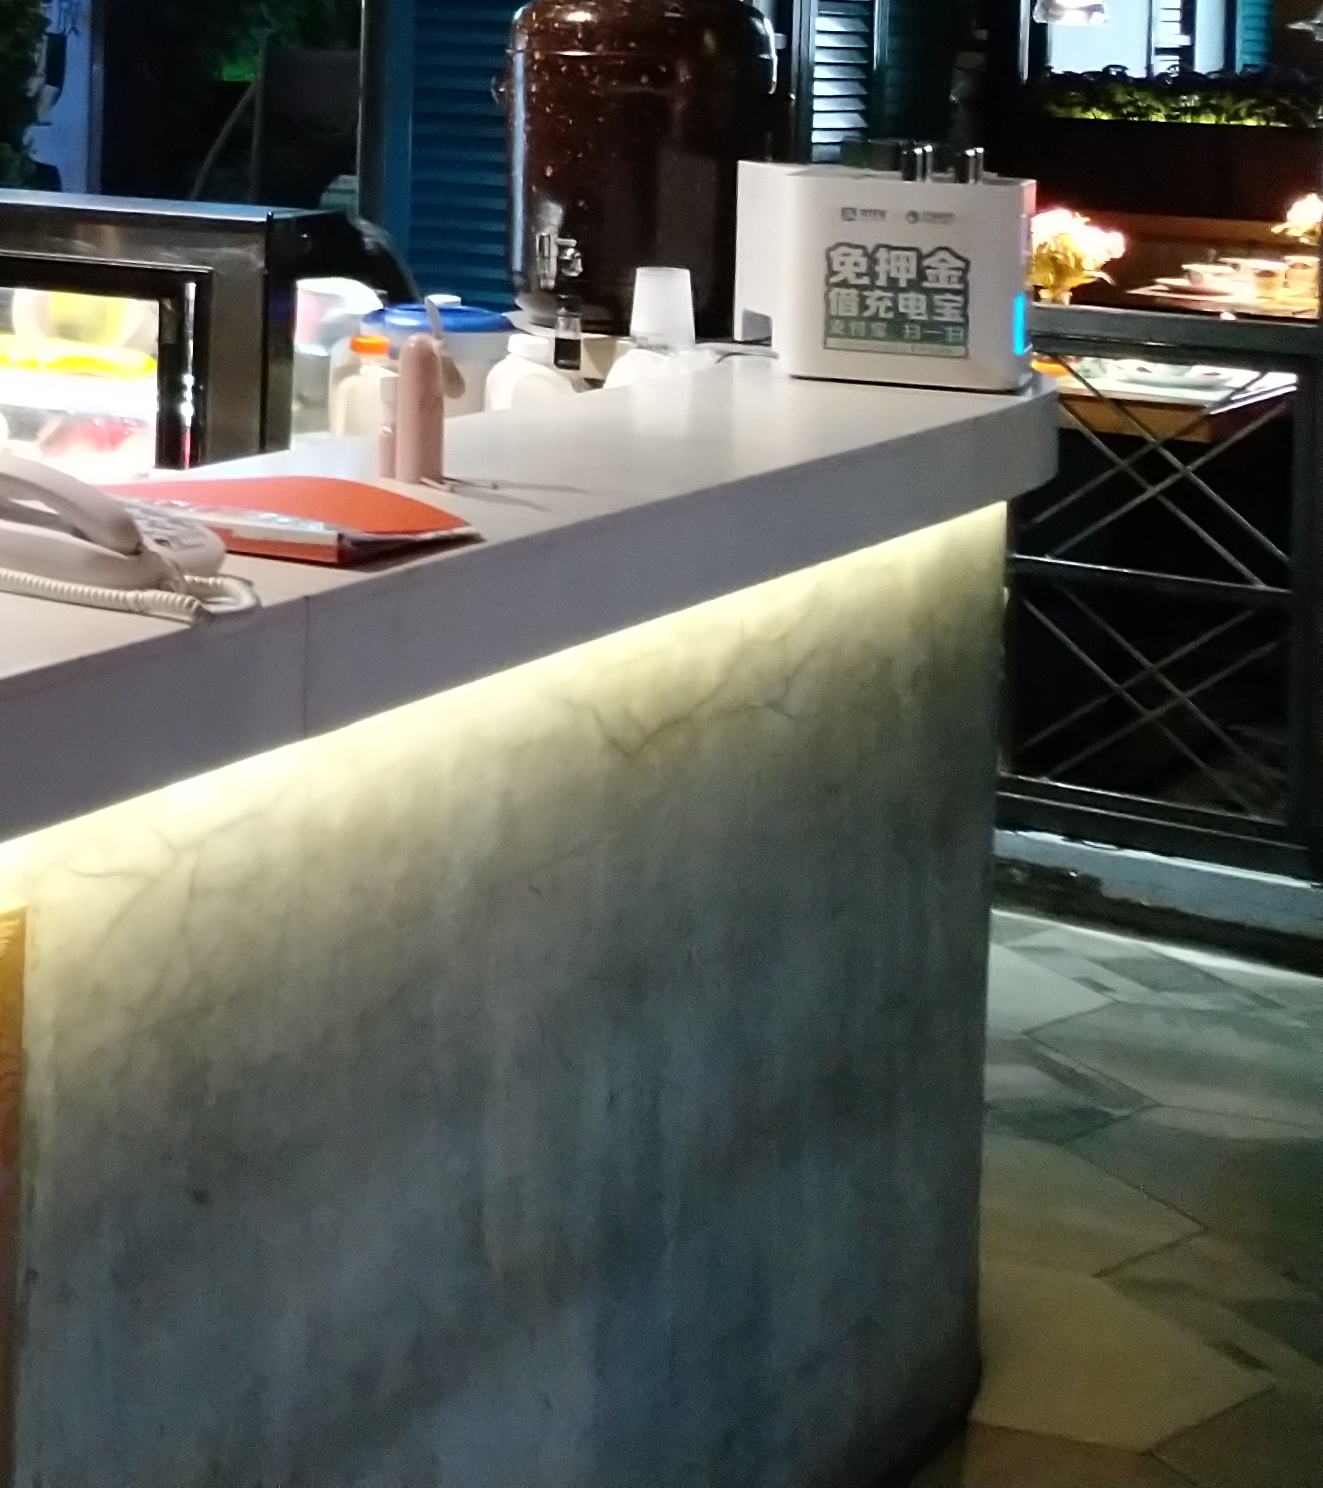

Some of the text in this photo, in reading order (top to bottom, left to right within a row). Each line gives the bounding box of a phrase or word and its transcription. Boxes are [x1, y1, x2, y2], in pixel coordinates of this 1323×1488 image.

[828, 244, 969, 289] 免押金
[827, 288, 966, 323] 借充电宝
